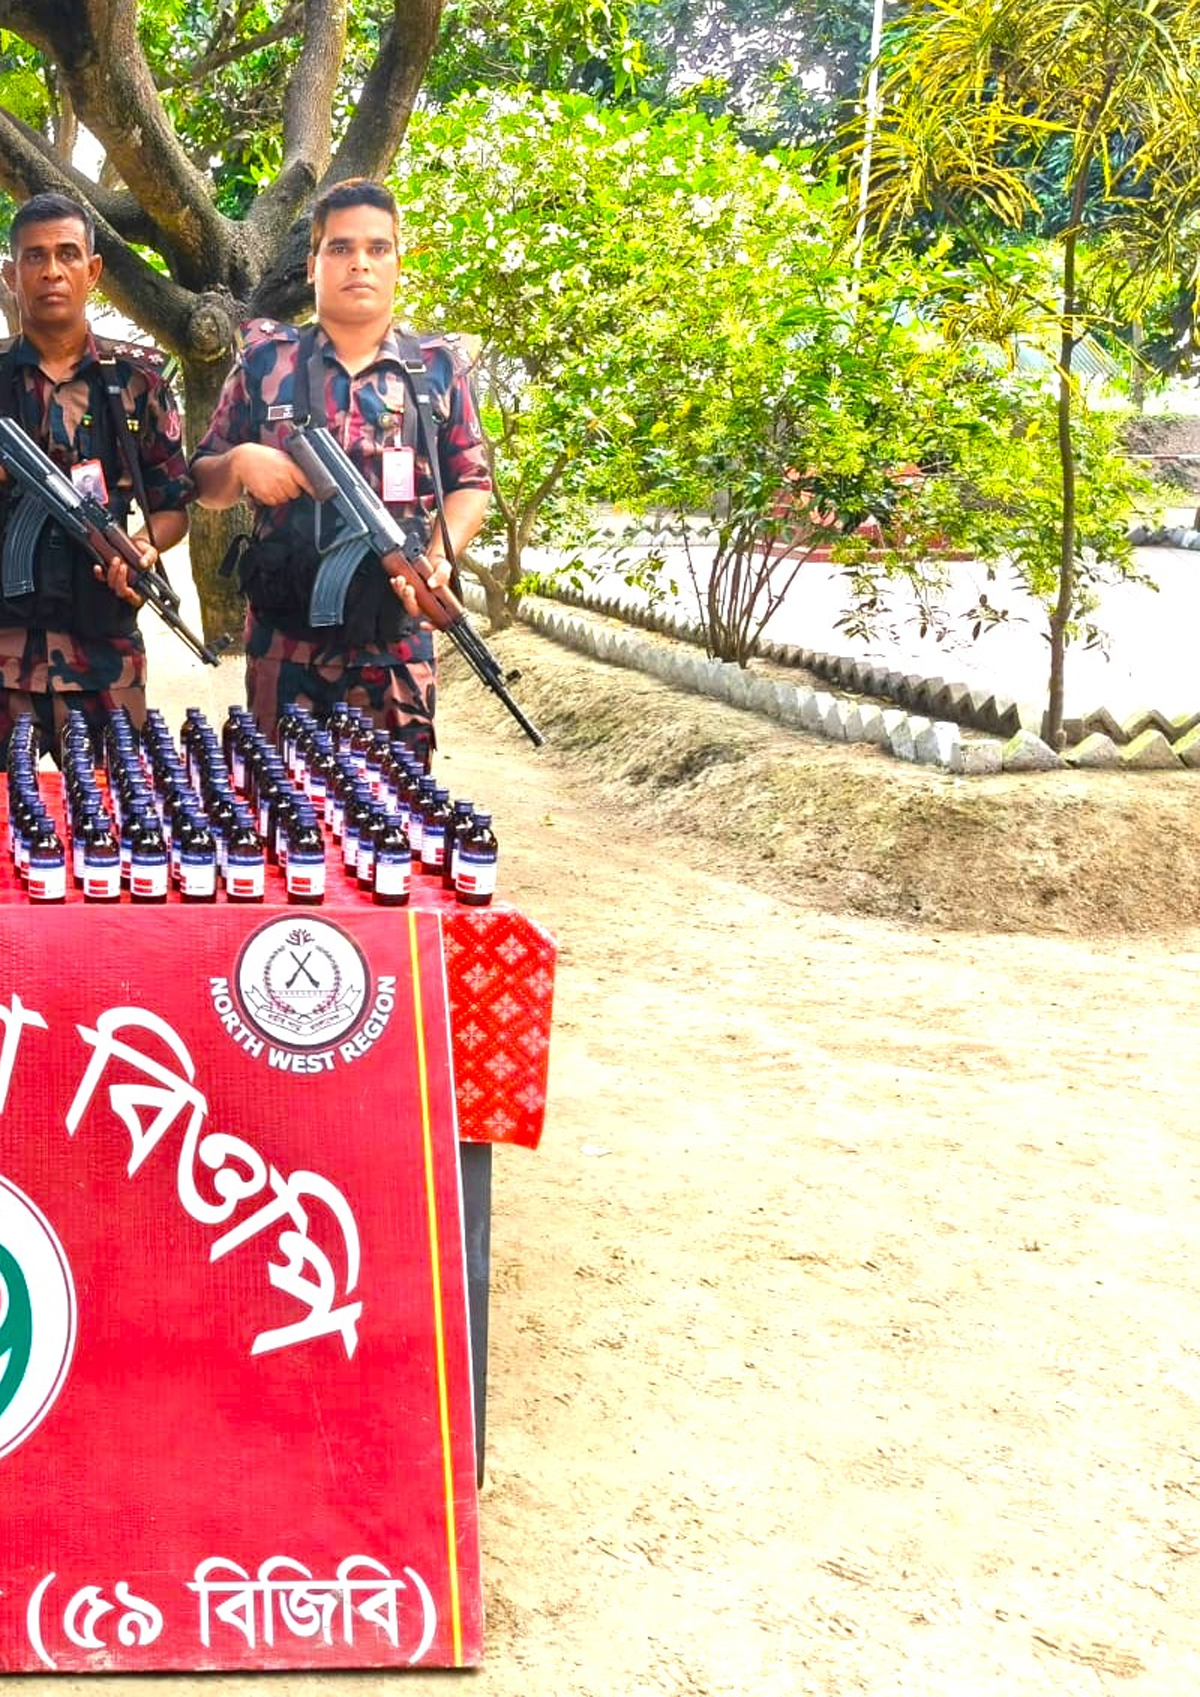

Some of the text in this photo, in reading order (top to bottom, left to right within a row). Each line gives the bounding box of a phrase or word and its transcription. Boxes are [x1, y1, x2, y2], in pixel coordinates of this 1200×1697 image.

[209, 976, 397, 1072] NORTH WEST REGION
[65, 1006, 363, 1360] বিওপি
[26, 1572, 163, 1668] (৫৯
[187, 1555, 437, 1664] বিজিবি)
